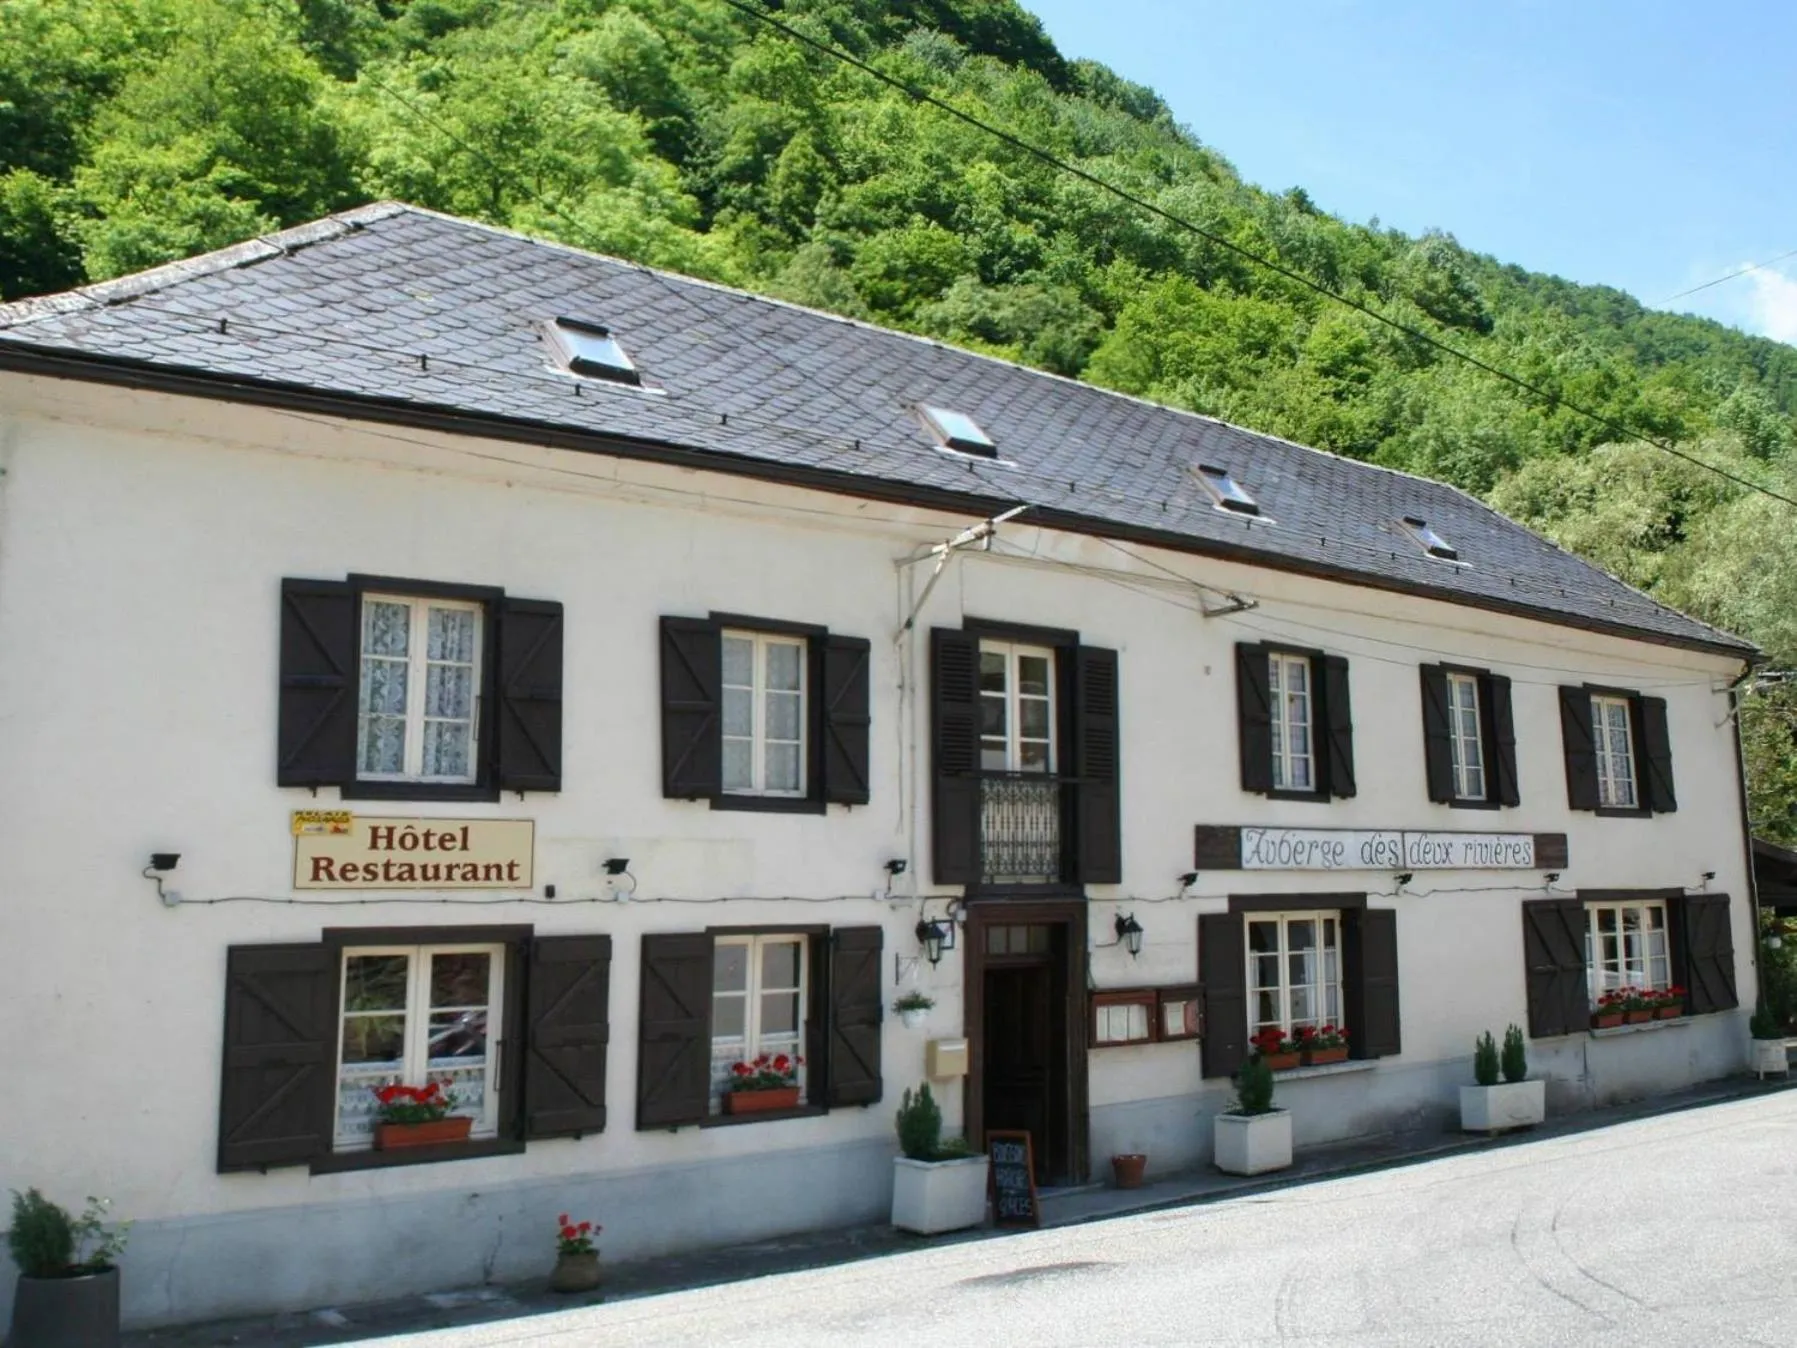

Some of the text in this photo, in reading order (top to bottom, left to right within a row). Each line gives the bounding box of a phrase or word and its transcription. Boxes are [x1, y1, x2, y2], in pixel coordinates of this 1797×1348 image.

[368, 825, 469, 851] Hôtel
[1409, 833, 1453, 865] deux
[1462, 835, 1532, 865] rivières
[309, 856, 520, 882] Restaurant
